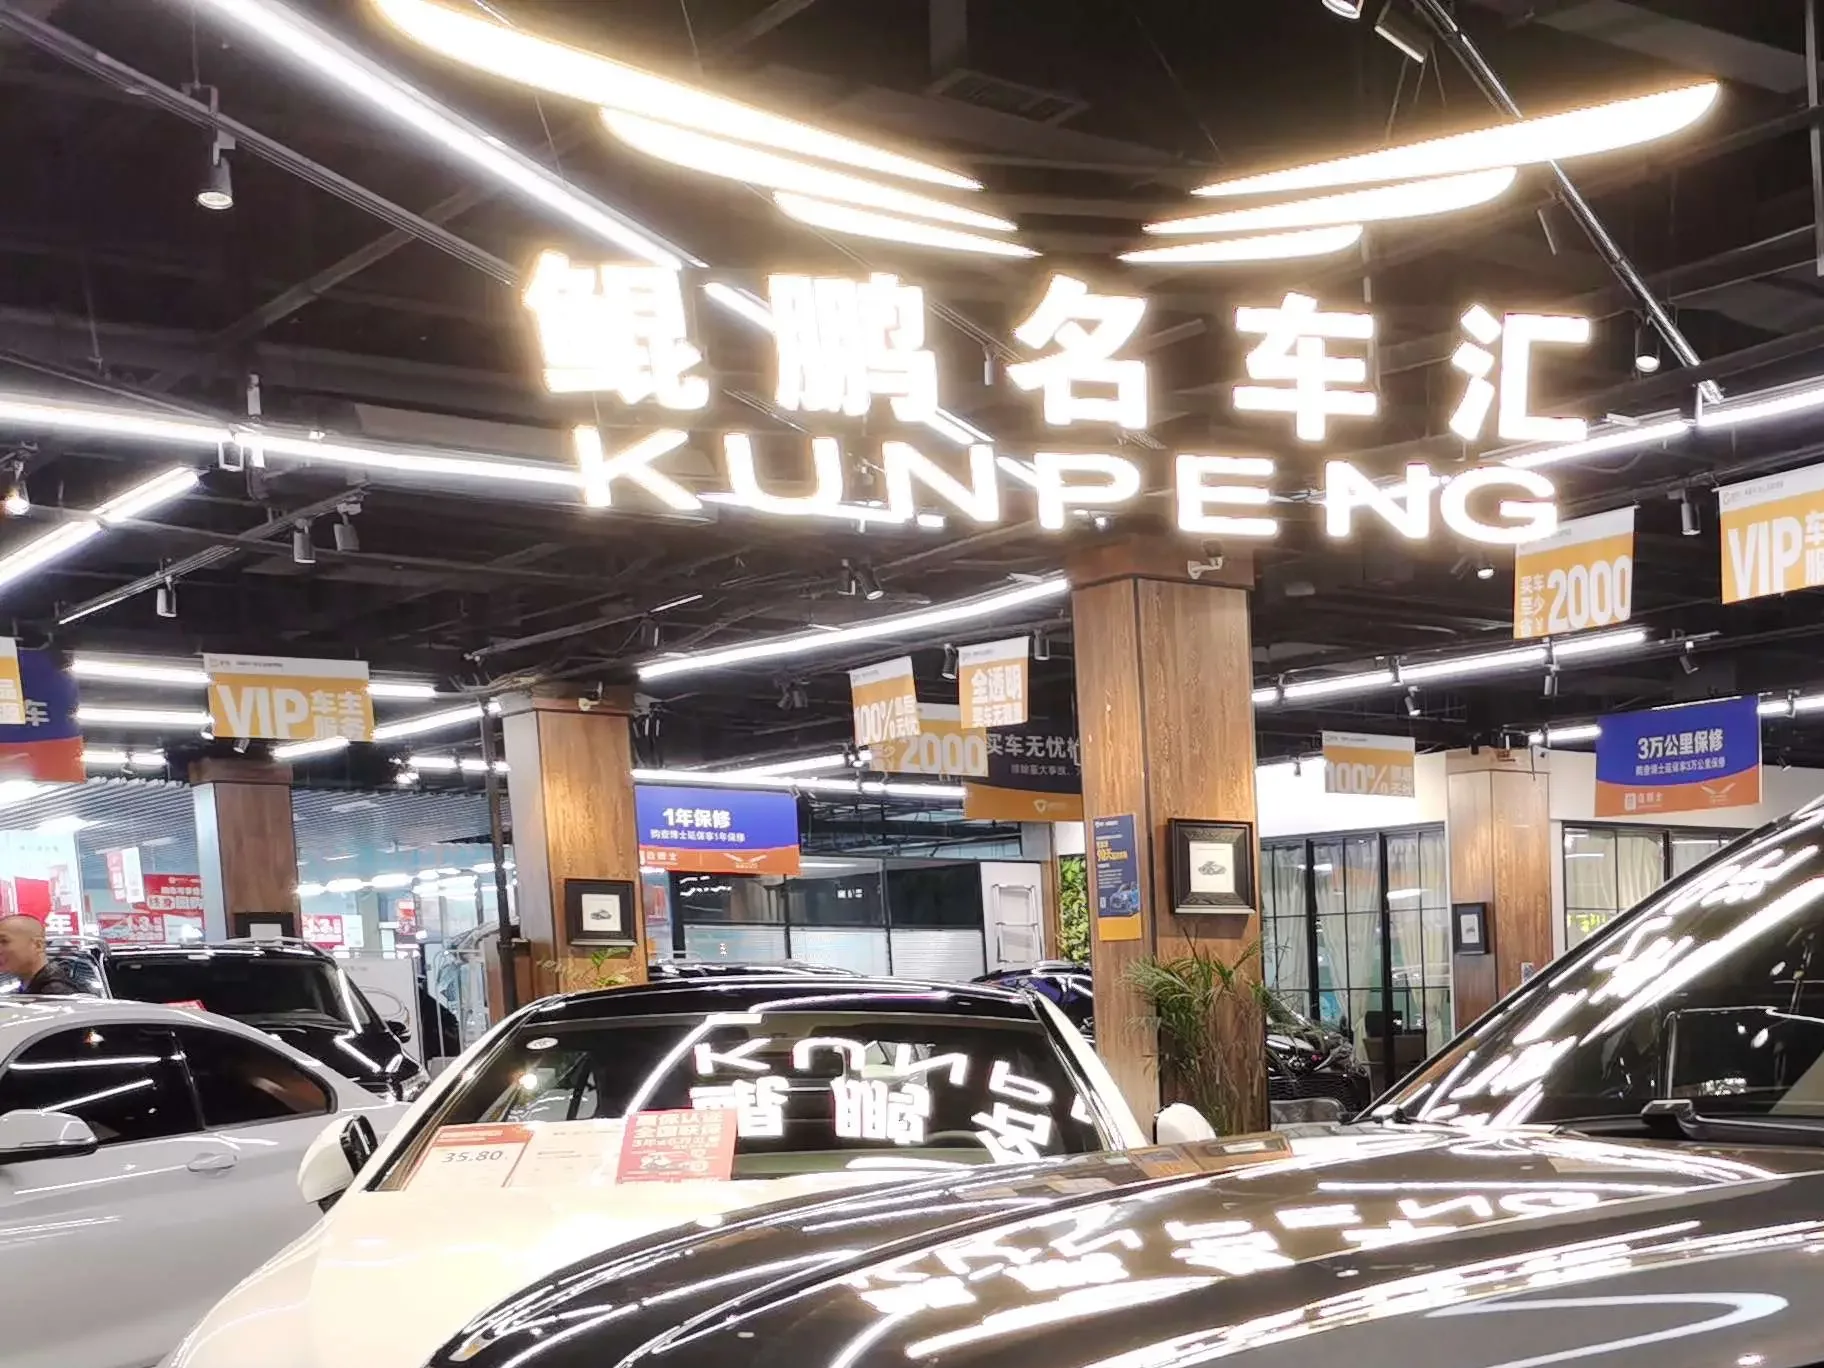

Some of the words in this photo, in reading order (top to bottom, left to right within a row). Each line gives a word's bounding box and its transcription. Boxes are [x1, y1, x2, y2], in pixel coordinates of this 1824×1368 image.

[573, 424, 1559, 546] KUNPENG
[1728, 516, 1803, 601] VIP
[1547, 554, 1633, 634] 2000
[216, 683, 310, 740] VIP
[310, 689, 365, 717] 车主
[854, 698, 895, 747] 100%
[900, 731, 987, 776] 2000
[1637, 727, 1724, 760] 3万公里保修
[1324, 761, 1389, 794] 100%
[662, 807, 732, 829] 1年保修
